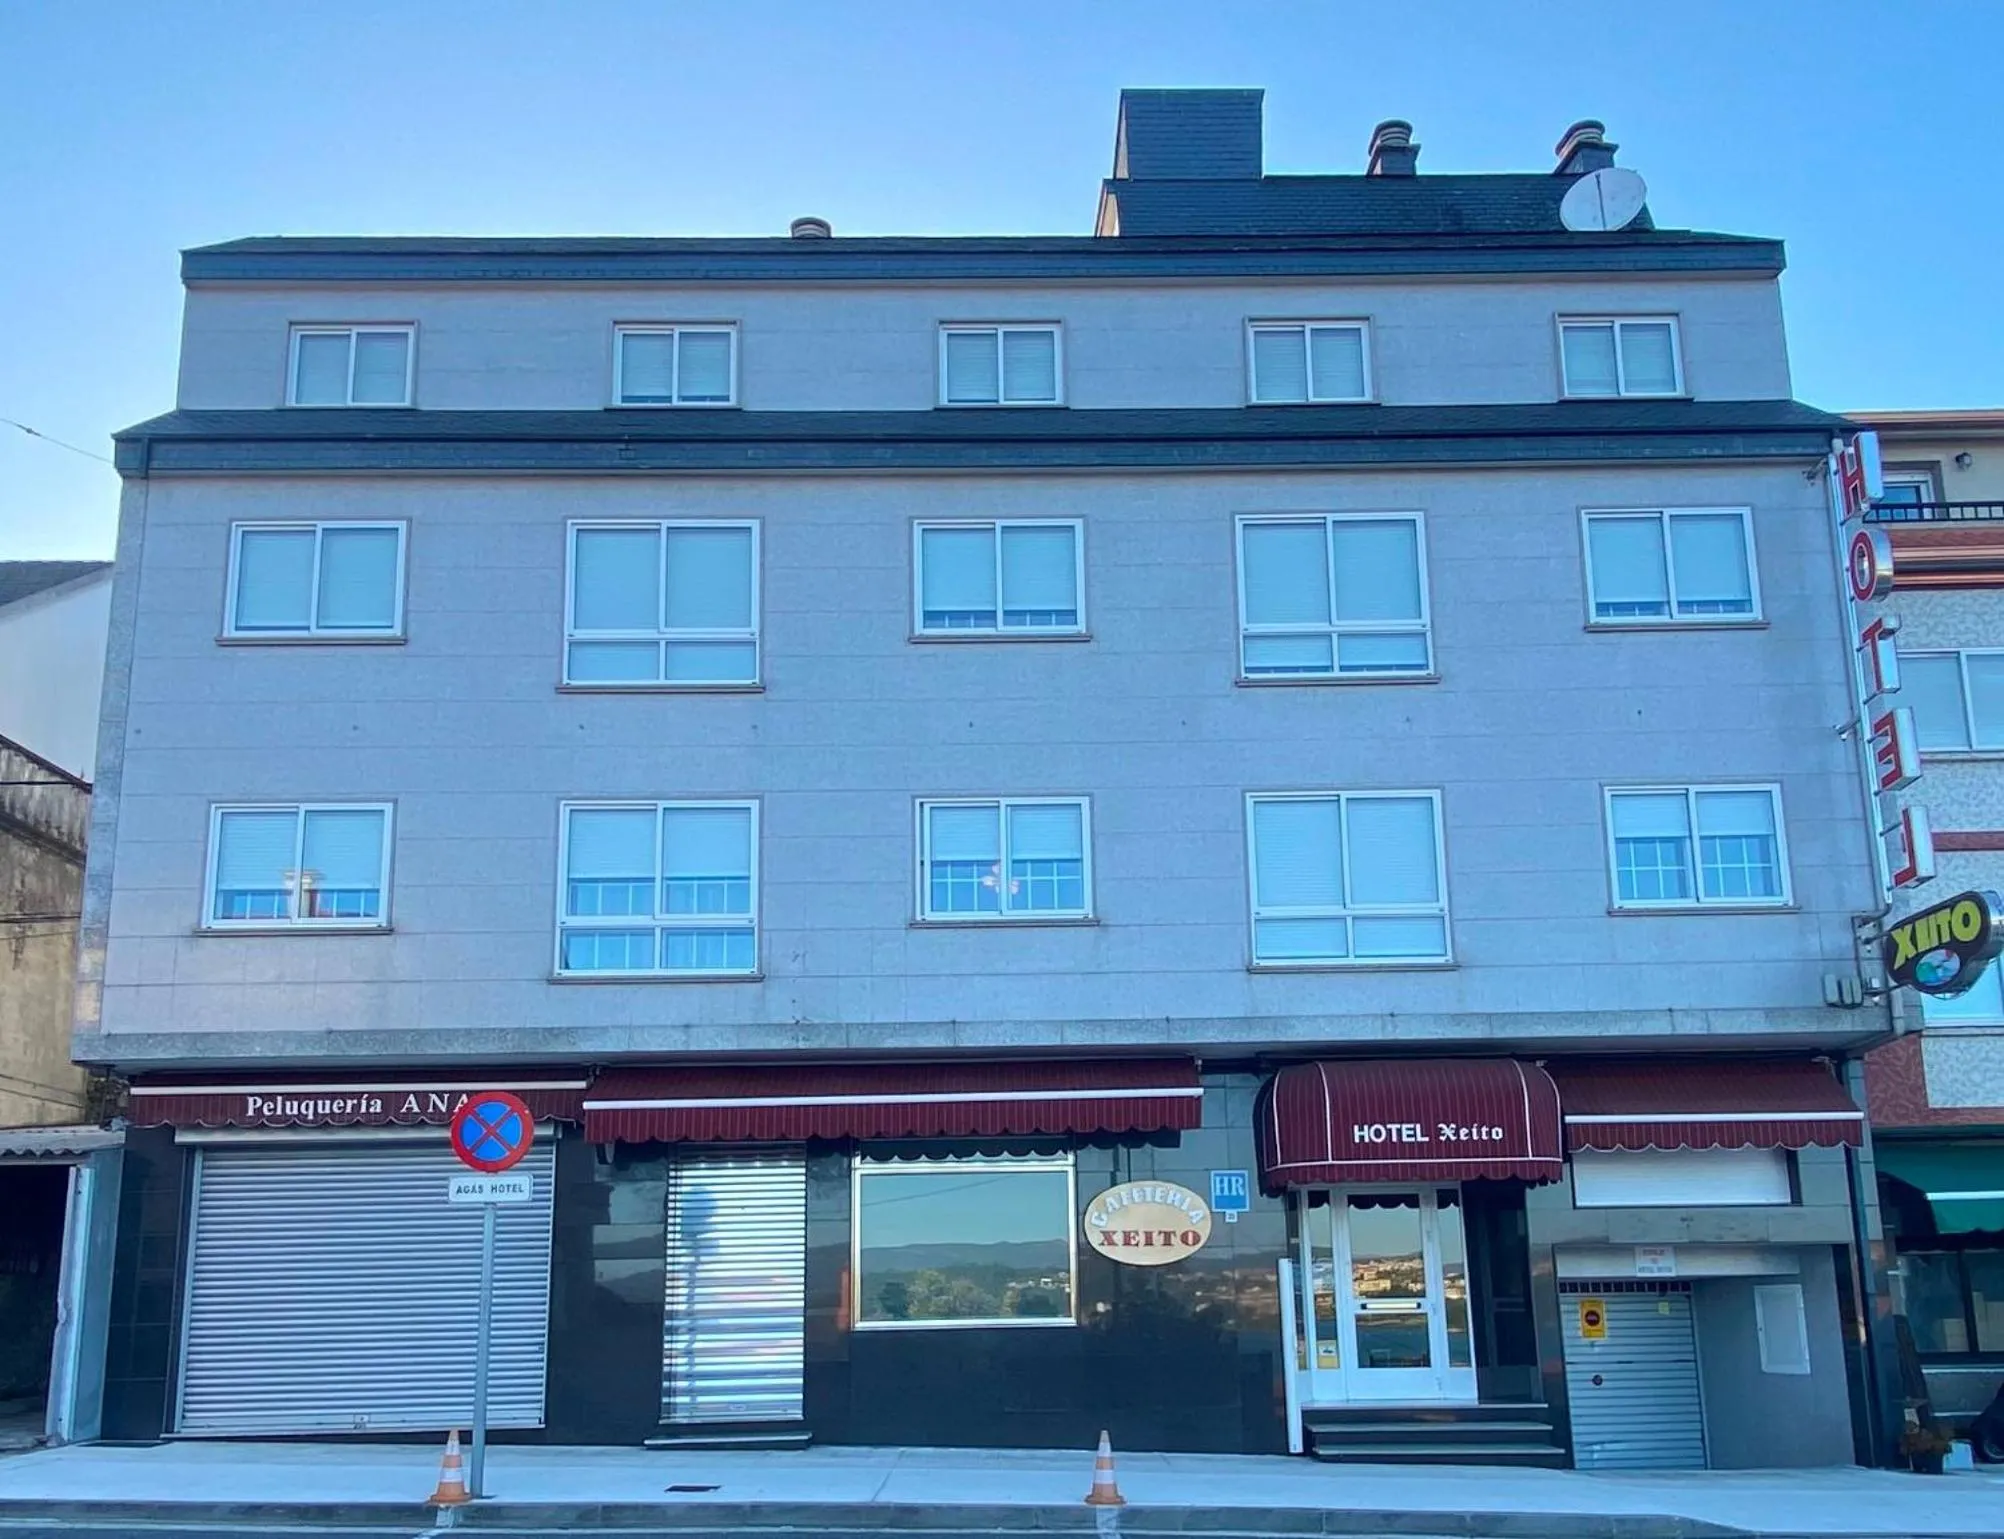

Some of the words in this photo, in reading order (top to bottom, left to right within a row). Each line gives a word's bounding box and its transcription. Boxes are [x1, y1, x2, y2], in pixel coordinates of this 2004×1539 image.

[246, 1094, 383, 1119] Peluquería
[1353, 1123, 1430, 1143] HOTEL
[1437, 1123, 1504, 1141] Xeito
[491, 1184, 525, 1194] HOTEL
[1215, 1175, 1245, 1196] HR
[1098, 1229, 1202, 1246] XEITO
